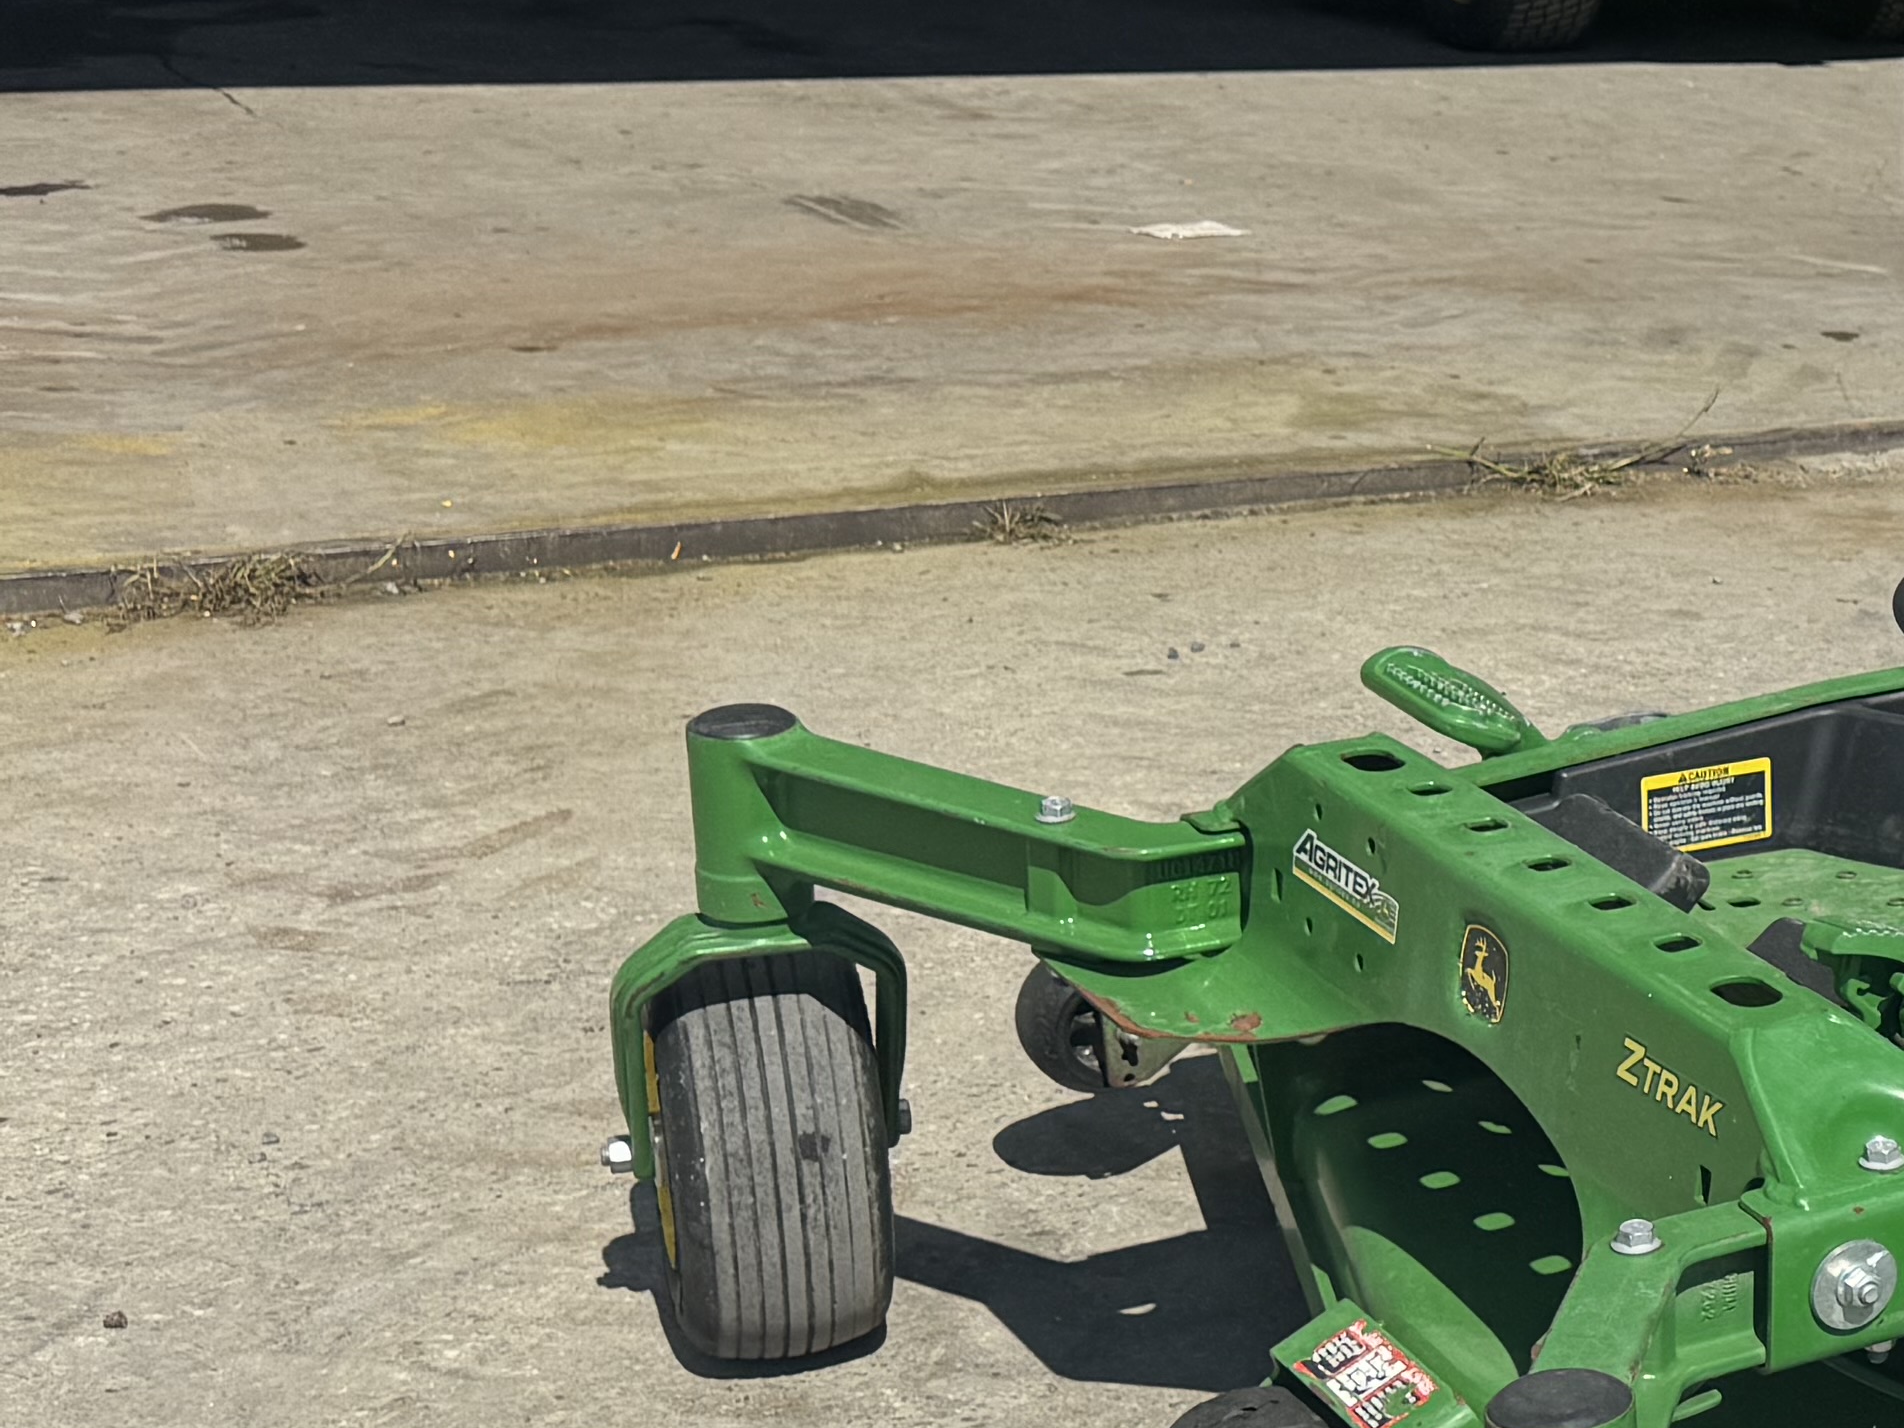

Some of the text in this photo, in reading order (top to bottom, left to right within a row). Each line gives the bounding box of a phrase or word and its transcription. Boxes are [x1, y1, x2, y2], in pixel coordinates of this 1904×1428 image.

[1688, 766, 1729, 781] CAUTION
[1296, 832, 1376, 907] AGRITEX
[1616, 1036, 1724, 1138] ZTRAK
